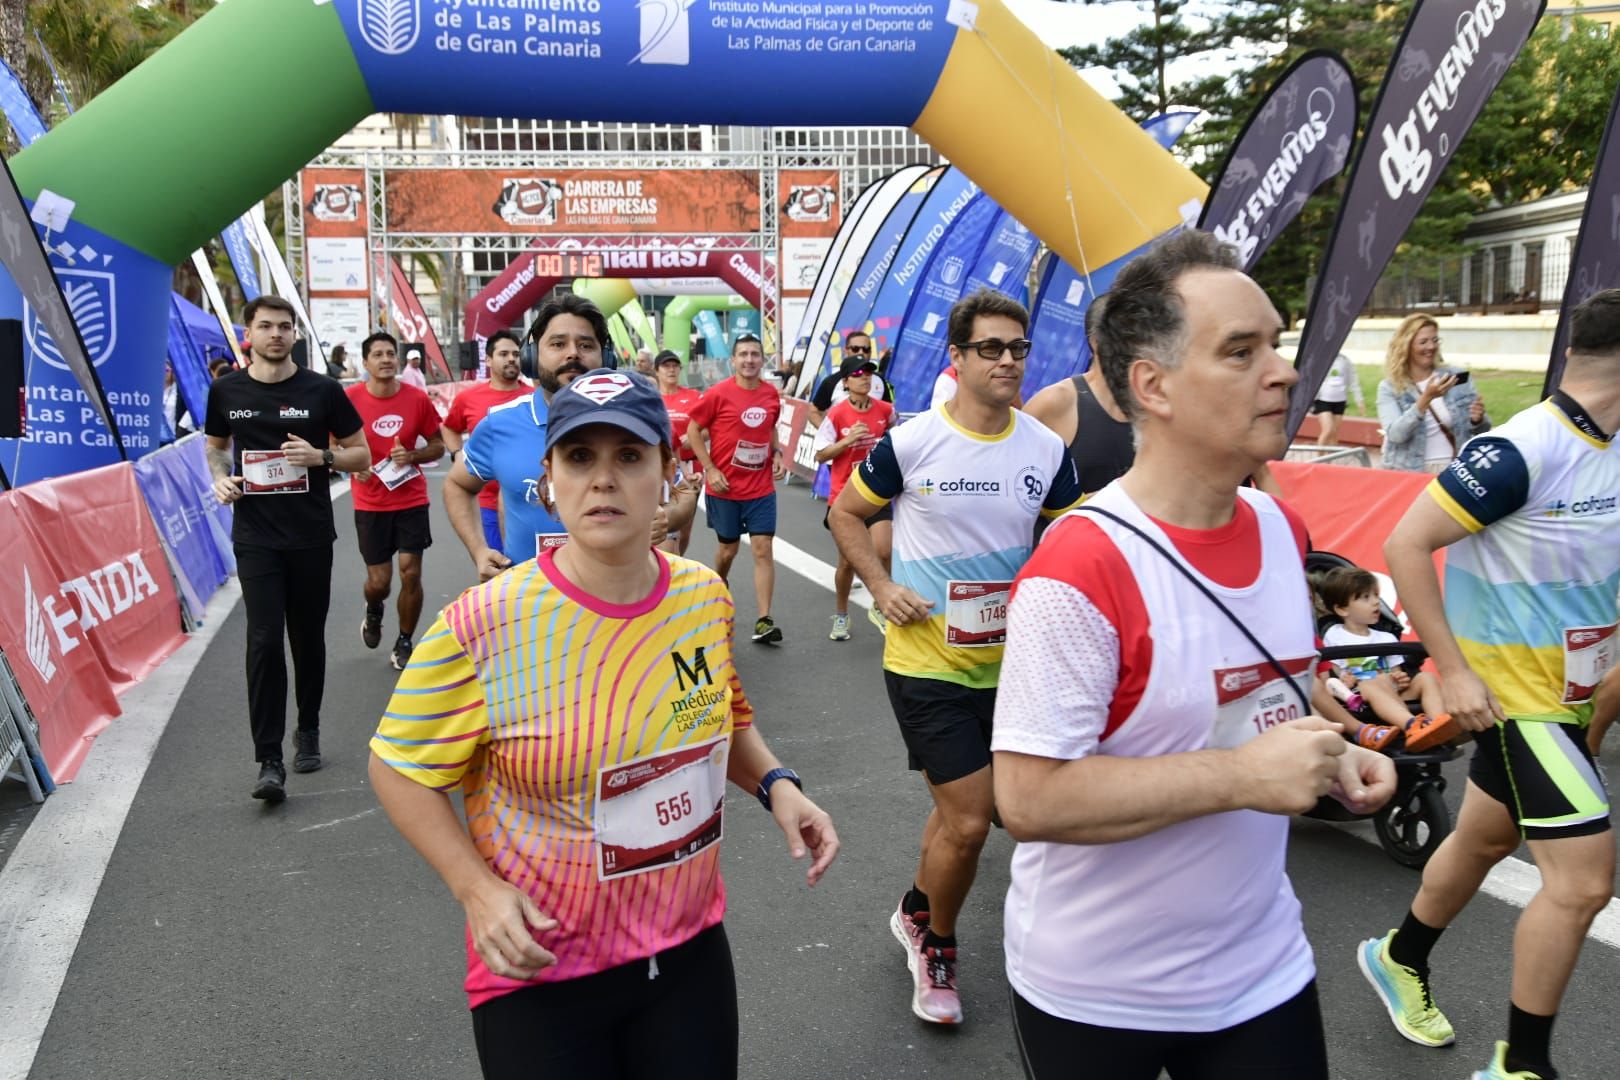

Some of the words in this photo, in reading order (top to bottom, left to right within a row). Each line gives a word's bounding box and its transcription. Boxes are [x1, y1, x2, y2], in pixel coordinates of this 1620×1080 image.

[709, 0, 759, 14] Instituto
[762, 1, 821, 17] Municipal
[825, 4, 852, 16] para
[856, 2, 866, 15] la
[870, 4, 933, 15] Promoción
[434, 11, 462, 28] de
[476, 11, 511, 31] Las
[525, 14, 601, 35] Palmas
[711, 16, 728, 27] de
[731, 17, 742, 28] la
[745, 17, 802, 30] Actividad
[805, 18, 837, 31] Física
[840, 21, 848, 34] y
[851, 19, 862, 31] el
[865, 19, 914, 33] Deporte
[917, 19, 933, 31] de
[435, 32, 462, 51] de
[466, 34, 517, 54] Gran
[524, 37, 601, 58] Canaria
[728, 35, 750, 50] Las
[754, 35, 801, 51] Palmas
[805, 36, 823, 51] de
[827, 37, 861, 51] Gran
[865, 37, 916, 51] Canaria
[1416, 0, 1506, 133] EVENTOS
[1246, 111, 1327, 223] EVENTOS
[565, 181, 625, 197] CARRERA
[627, 181, 642, 197] DE
[565, 198, 589, 214] LAS
[591, 198, 657, 214] EMPRESAS
[894, 222, 945, 287] INSTITUTO
[939, 181, 981, 225] INSULA
[28, 404, 65, 423] Las
[229, 410, 253, 420] DAG
[743, 412, 766, 420] ICOT
[374, 420, 404, 429] ICOT
[266, 467, 284, 479] 374
[939, 477, 1000, 491] cofarca
[1024, 474, 1043, 496] 90
[979, 605, 1007, 623] 1748
[674, 708, 712, 724] COLEGIO
[677, 722, 696, 733] LAS
[655, 791, 692, 826] 555
[605, 850, 616, 864] 11
